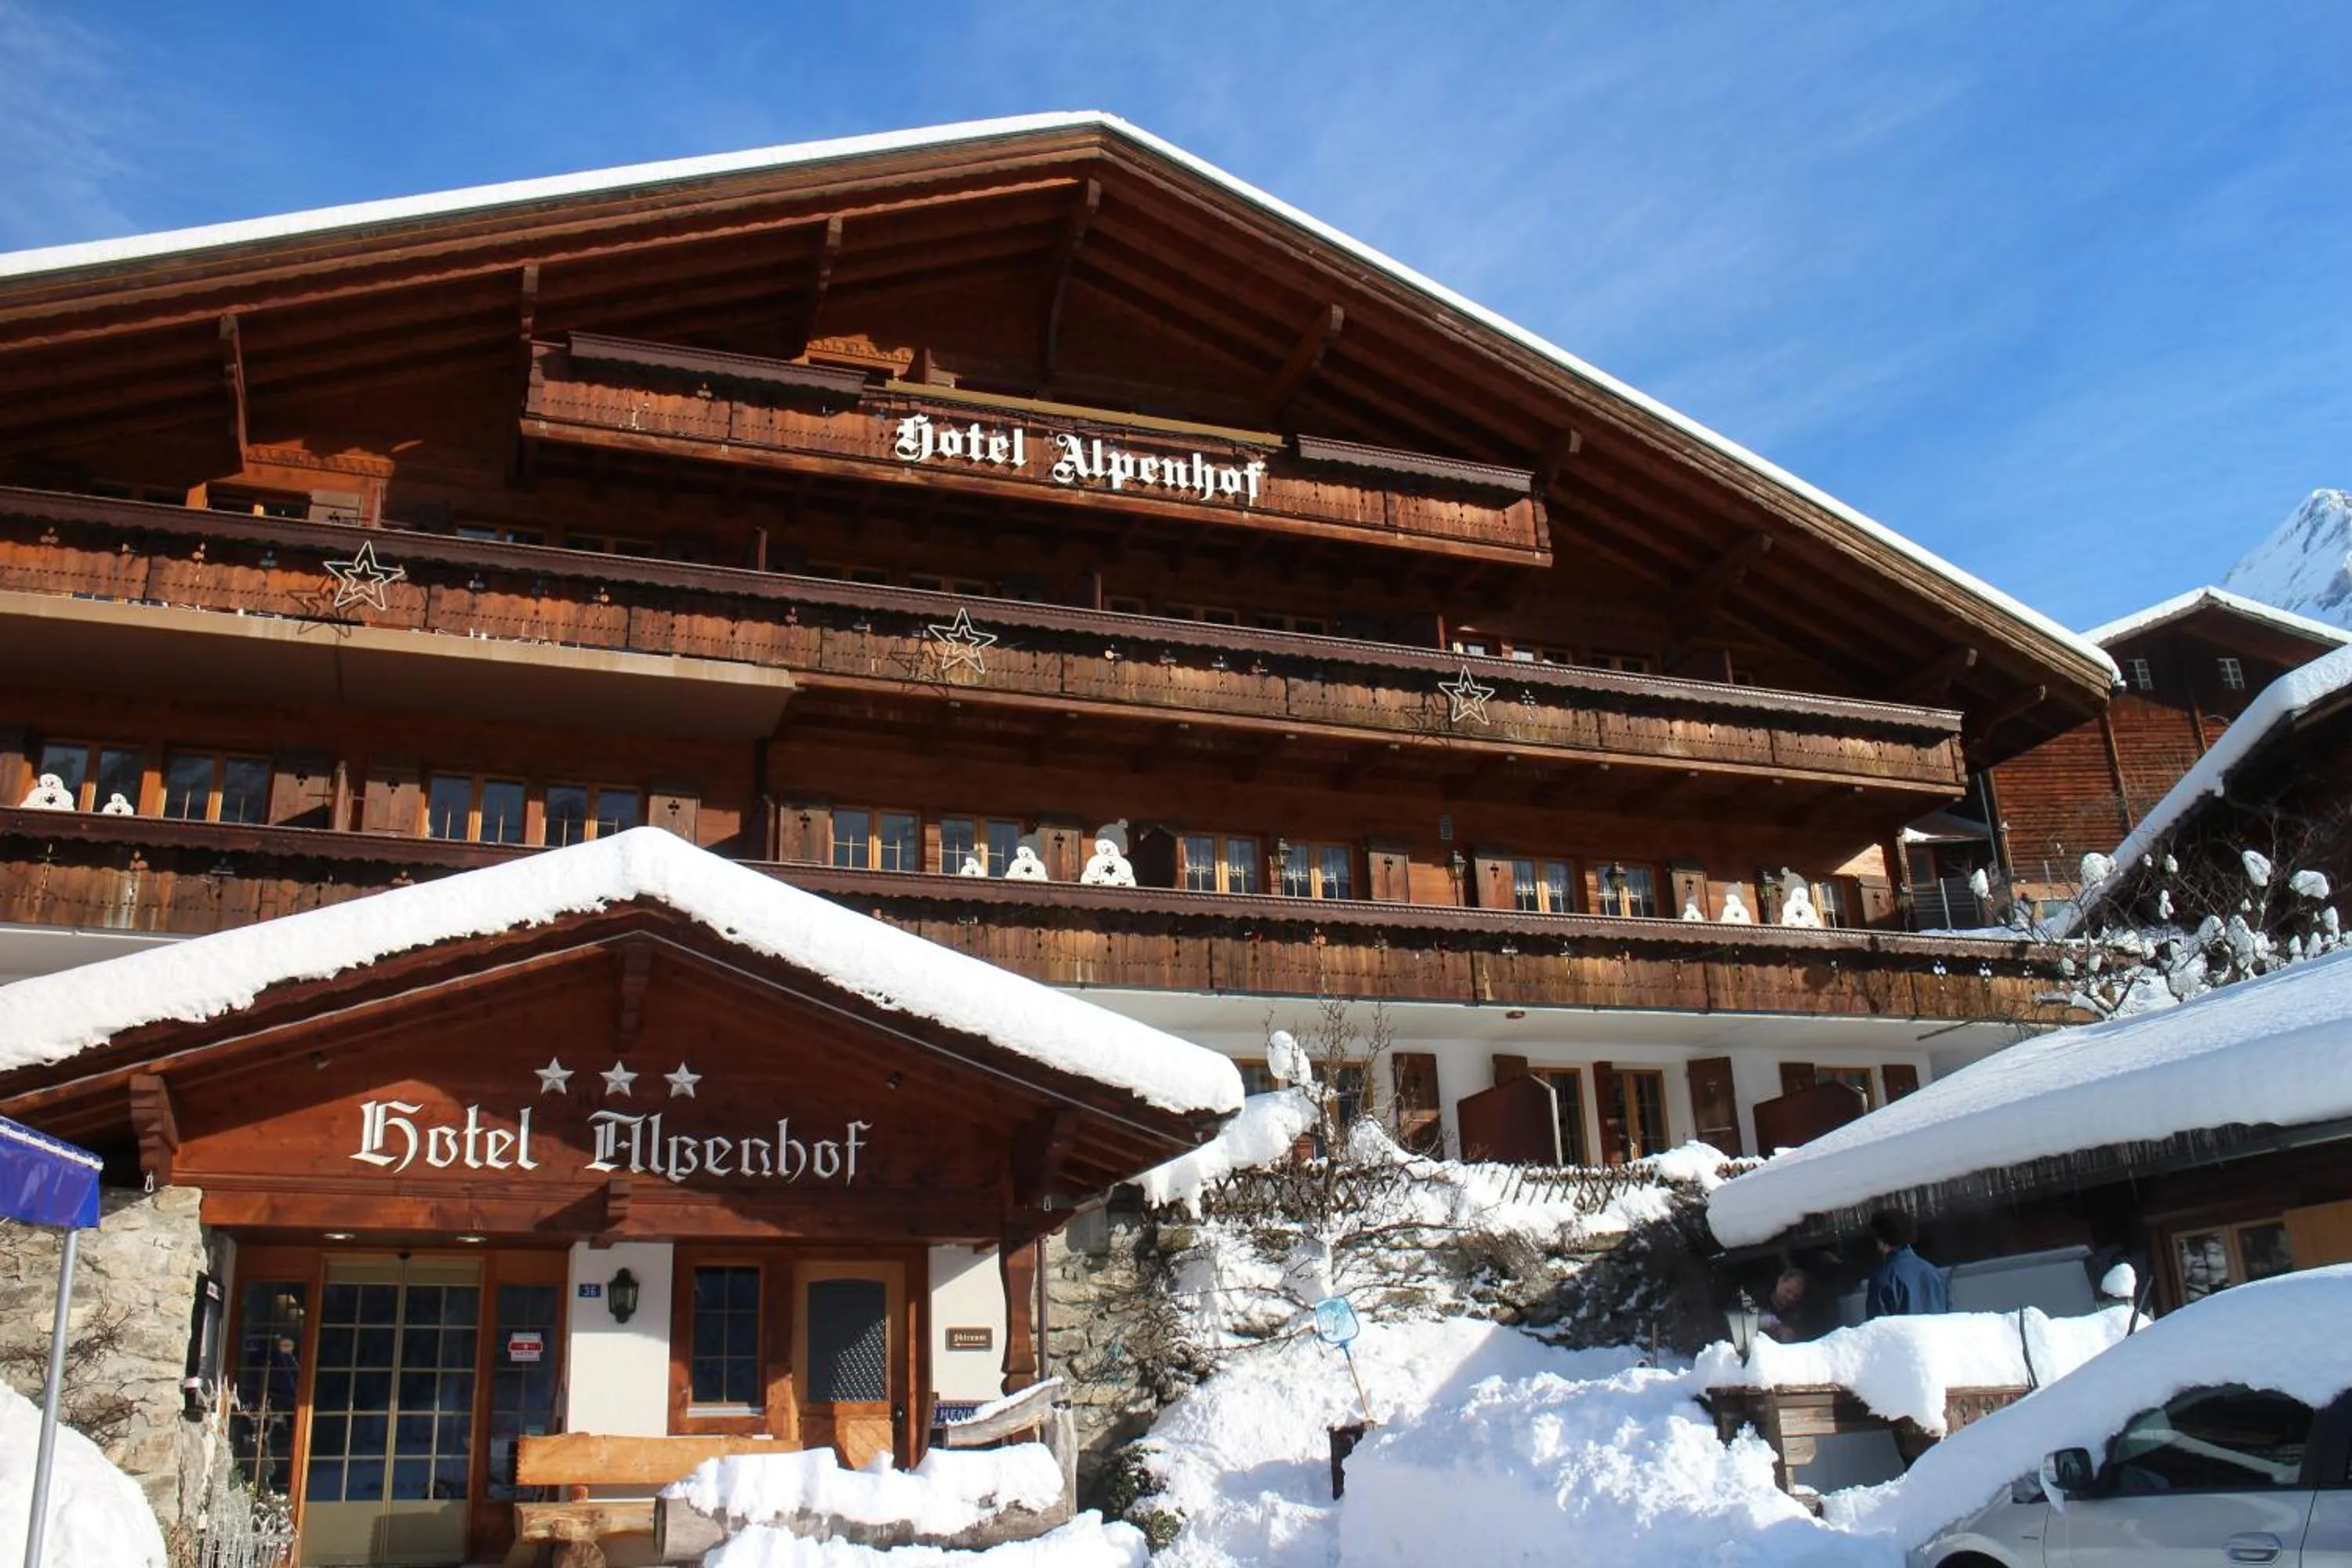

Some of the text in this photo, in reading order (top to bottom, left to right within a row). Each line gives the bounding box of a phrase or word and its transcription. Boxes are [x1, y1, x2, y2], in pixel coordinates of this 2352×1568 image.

[895, 413, 1267, 506] Hotel Alpenhof
[349, 1099, 873, 1186] Hotel Alpenhof
